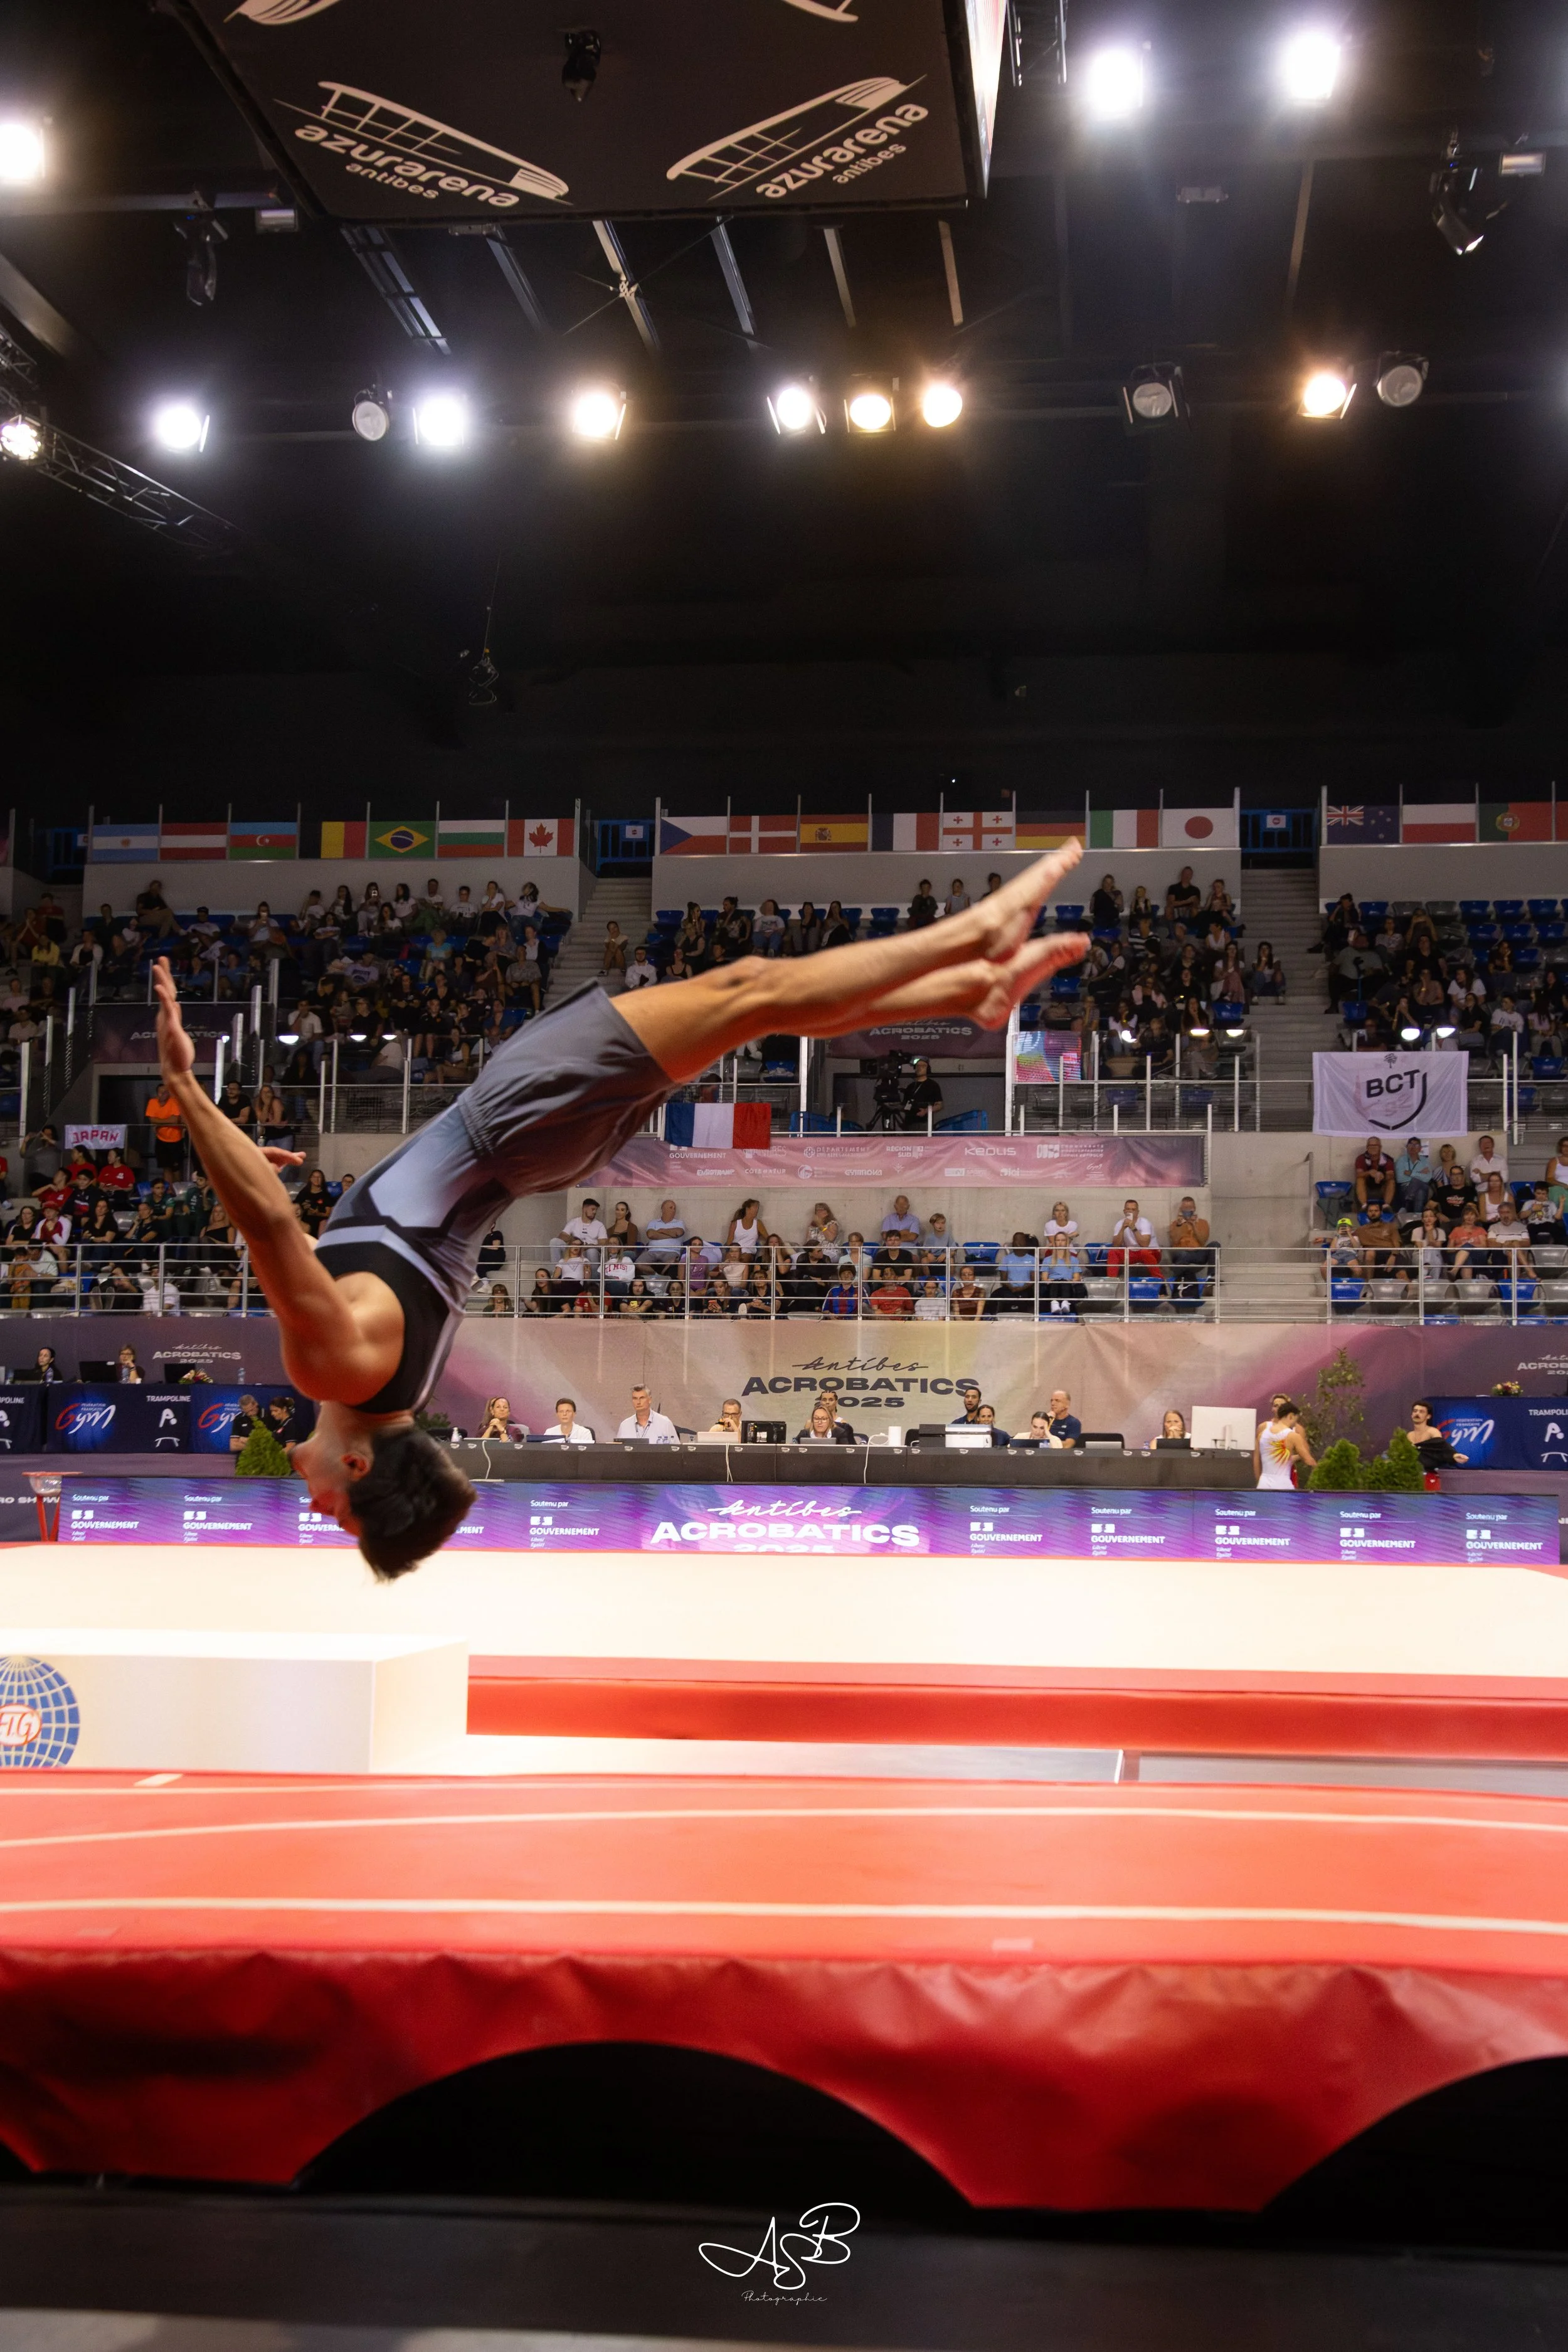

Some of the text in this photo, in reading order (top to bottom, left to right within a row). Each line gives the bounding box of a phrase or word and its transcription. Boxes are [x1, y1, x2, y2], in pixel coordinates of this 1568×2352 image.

[756, 103, 929, 199] azurarena
[295, 125, 520, 208] azurarena
[832, 144, 907, 184] antibes
[345, 162, 440, 199] antibes
[869, 1027, 973, 1036] ACROBATICS
[1366, 1069, 1421, 1099] BCT
[72, 1130, 120, 1145] JAPAN
[152, 1351, 242, 1360] ACROBATICS
[792, 1357, 928, 1372] Antibes
[741, 1376, 980, 1397] ACROBATICS
[815, 1396, 905, 1408] 025
[55, 1402, 116, 1434] Gym
[707, 1499, 863, 1517] Antibes
[1465, 1512, 1495, 1520] Soutenu
[70, 1520, 139, 1530] GOUVERNEMENT
[183, 1522, 253, 1530] GOUVERNEMENT
[529, 1527, 600, 1536] GOUVERNEMENT
[650, 1522, 920, 1547] ACROBATICS
[970, 1534, 1042, 1542] GOUVERNEMENT
[1090, 1535, 1165, 1544] GOUVERNEMENT
[1214, 1537, 1291, 1546] GOUVERNEMENT
[1340, 1539, 1416, 1549] GOUVERNEMENT
[1465, 1541, 1544, 1550] GOUVERNEMENT
